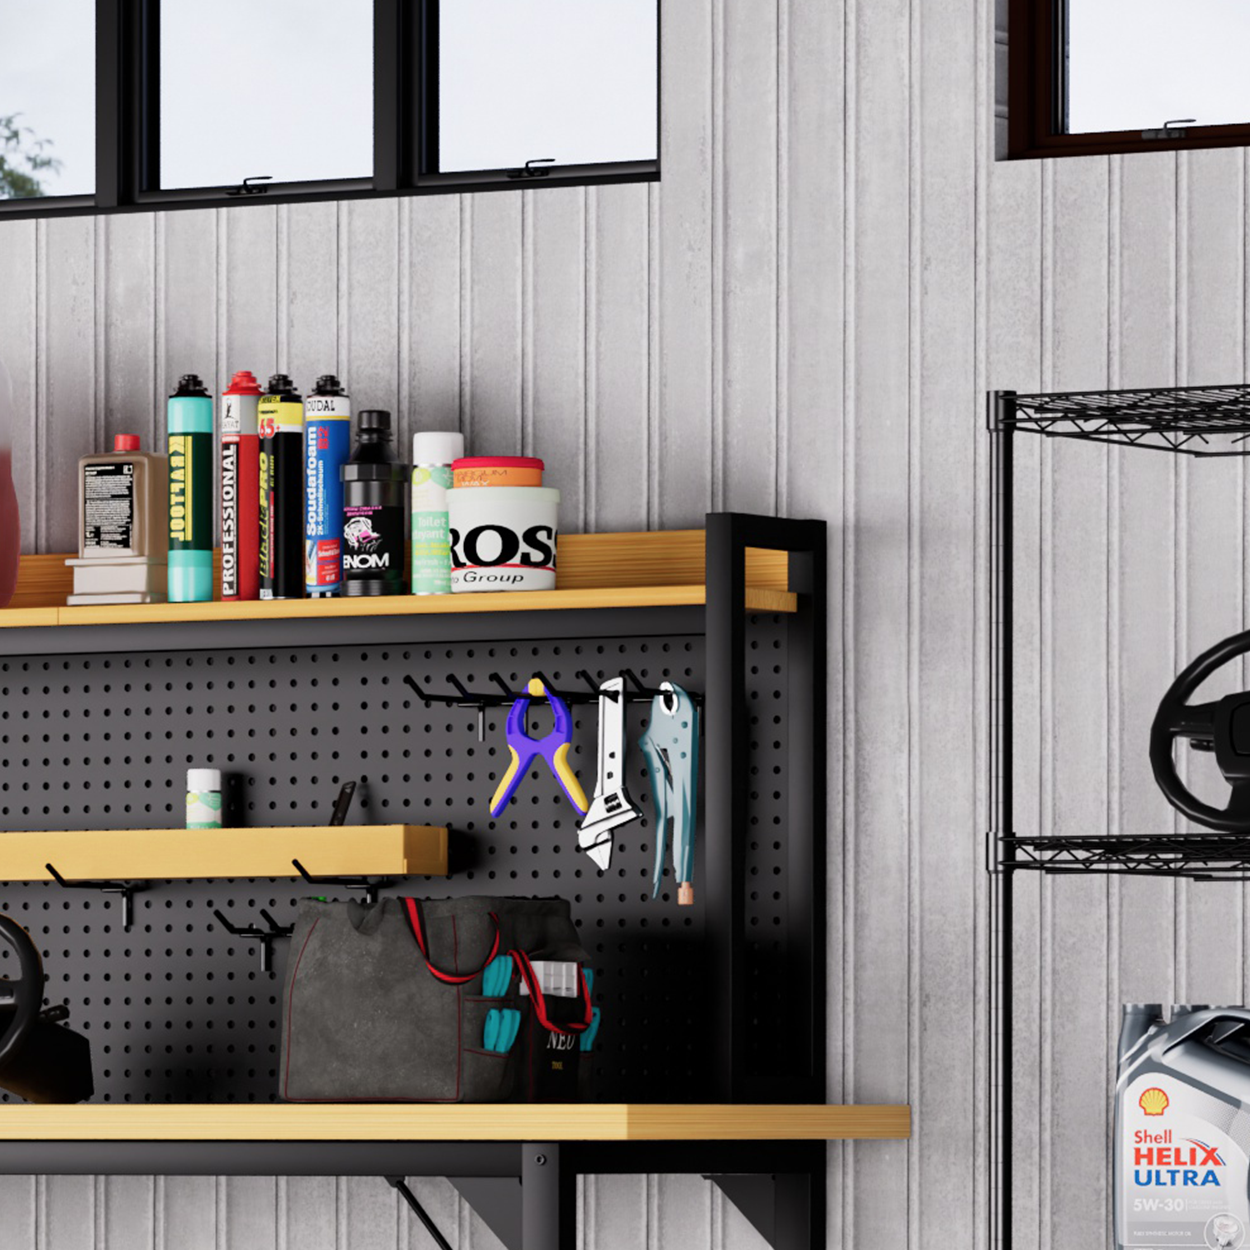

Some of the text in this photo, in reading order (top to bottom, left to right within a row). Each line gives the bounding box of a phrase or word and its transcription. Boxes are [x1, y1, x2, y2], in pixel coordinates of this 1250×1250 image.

[307, 426, 317, 536] Soudafoam
[222, 444, 234, 595] PROFESSIONAL
[449, 525, 557, 568] ROS
[463, 571, 525, 584] Group
[1134, 1129, 1172, 1144] Shell
[1134, 1147, 1224, 1166] HELIX
[1134, 1169, 1221, 1186] ULTRA
[1133, 1199, 1184, 1212] 5W-30
